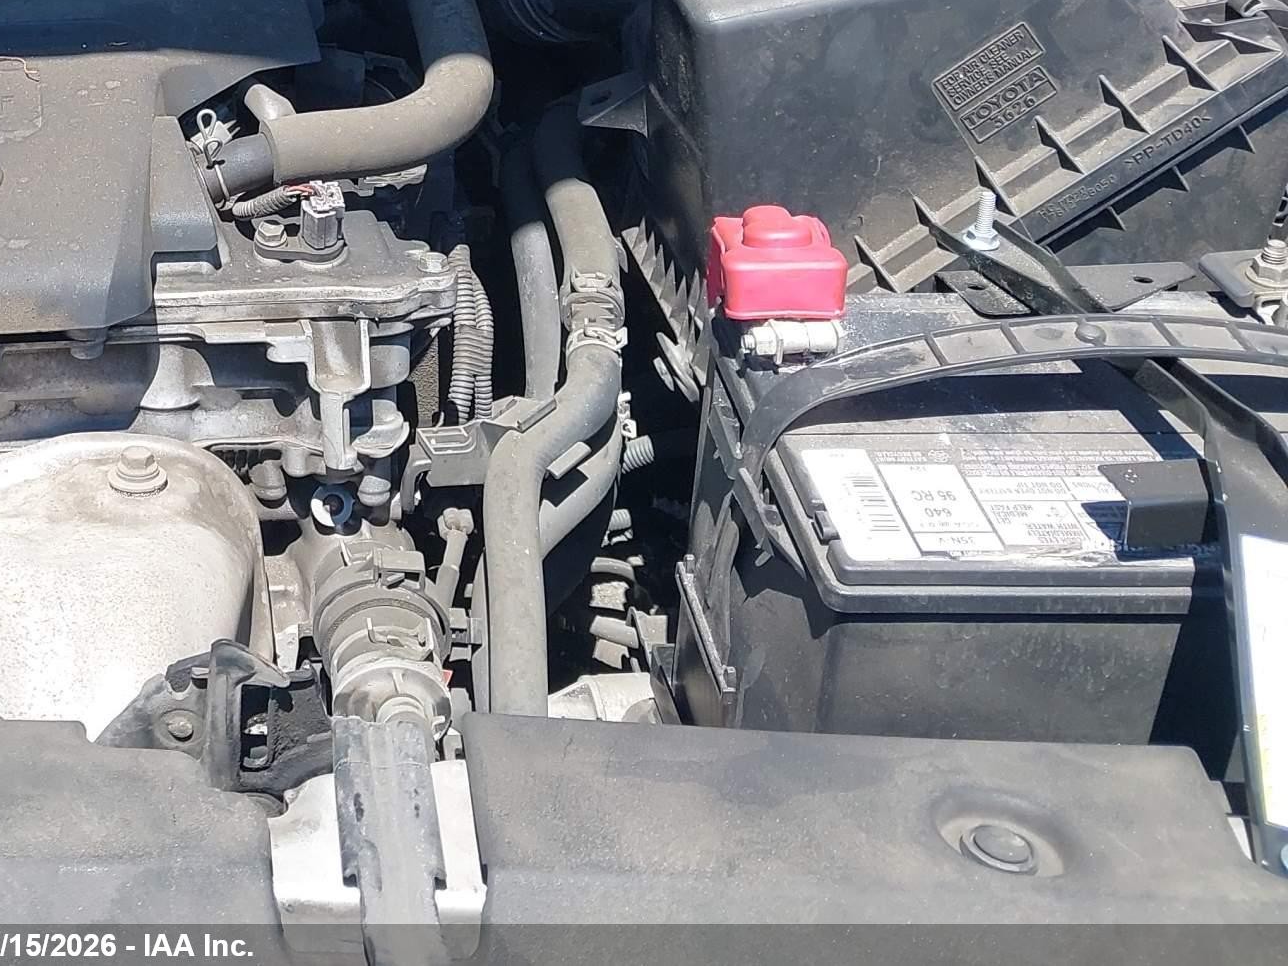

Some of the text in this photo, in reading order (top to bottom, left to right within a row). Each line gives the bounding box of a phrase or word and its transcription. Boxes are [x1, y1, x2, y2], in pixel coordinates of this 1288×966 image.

[940, 30, 1025, 89] FOR AIR CLEANER
[947, 52, 1010, 97] SERVICE SEE
[995, 48, 1038, 79] MANUAL
[964, 70, 1046, 127] TOYOTA
[990, 95, 1037, 129] 5626
[912, 490, 957, 501] 95 RC
[924, 507, 952, 518] 640
